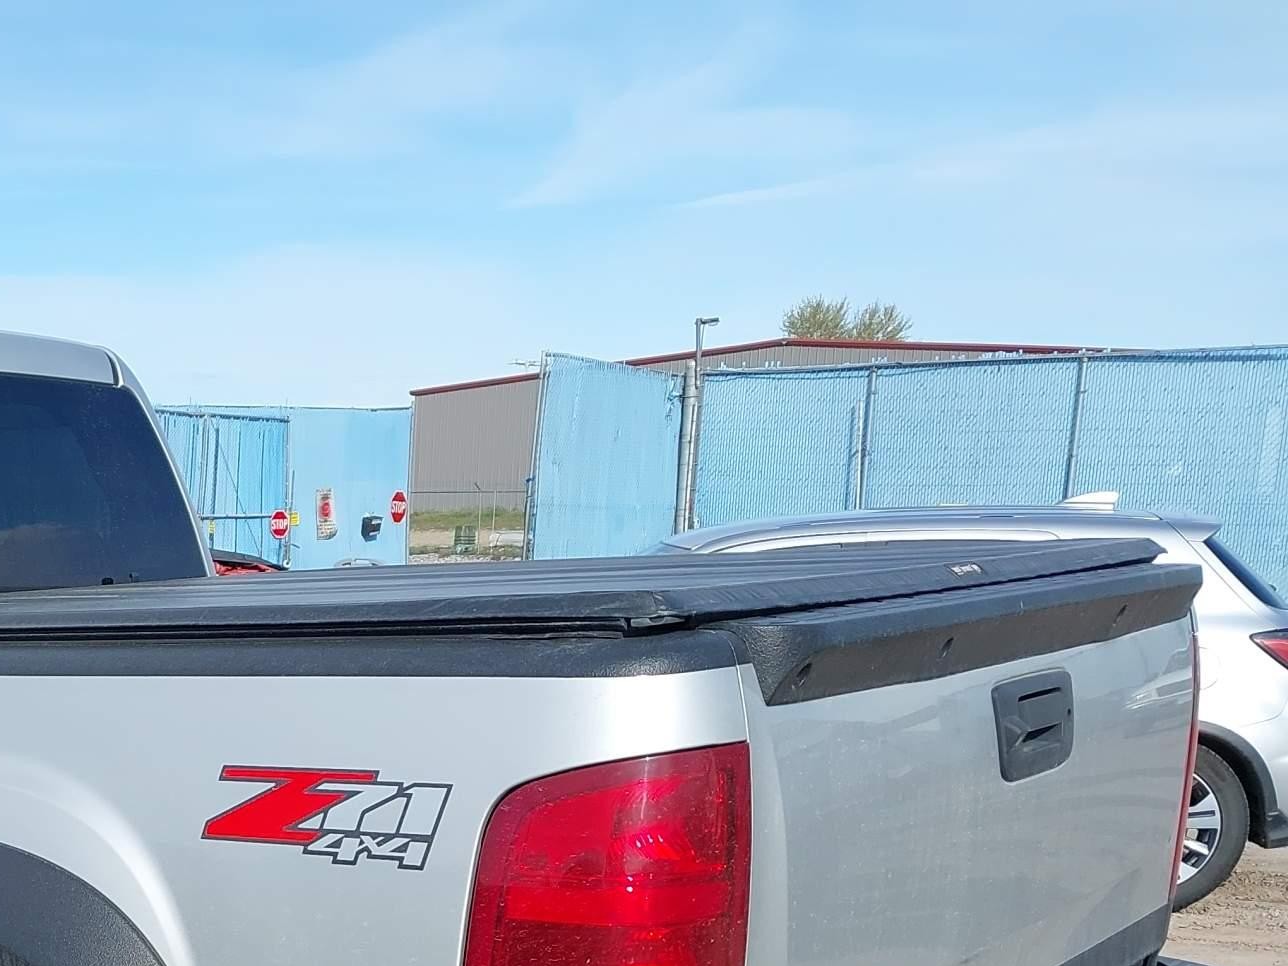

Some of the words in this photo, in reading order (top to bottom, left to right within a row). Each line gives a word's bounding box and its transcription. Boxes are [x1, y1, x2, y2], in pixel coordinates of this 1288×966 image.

[391, 500, 407, 514] STOP
[271, 518, 288, 530] STOP
[201, 765, 453, 846] Z71
